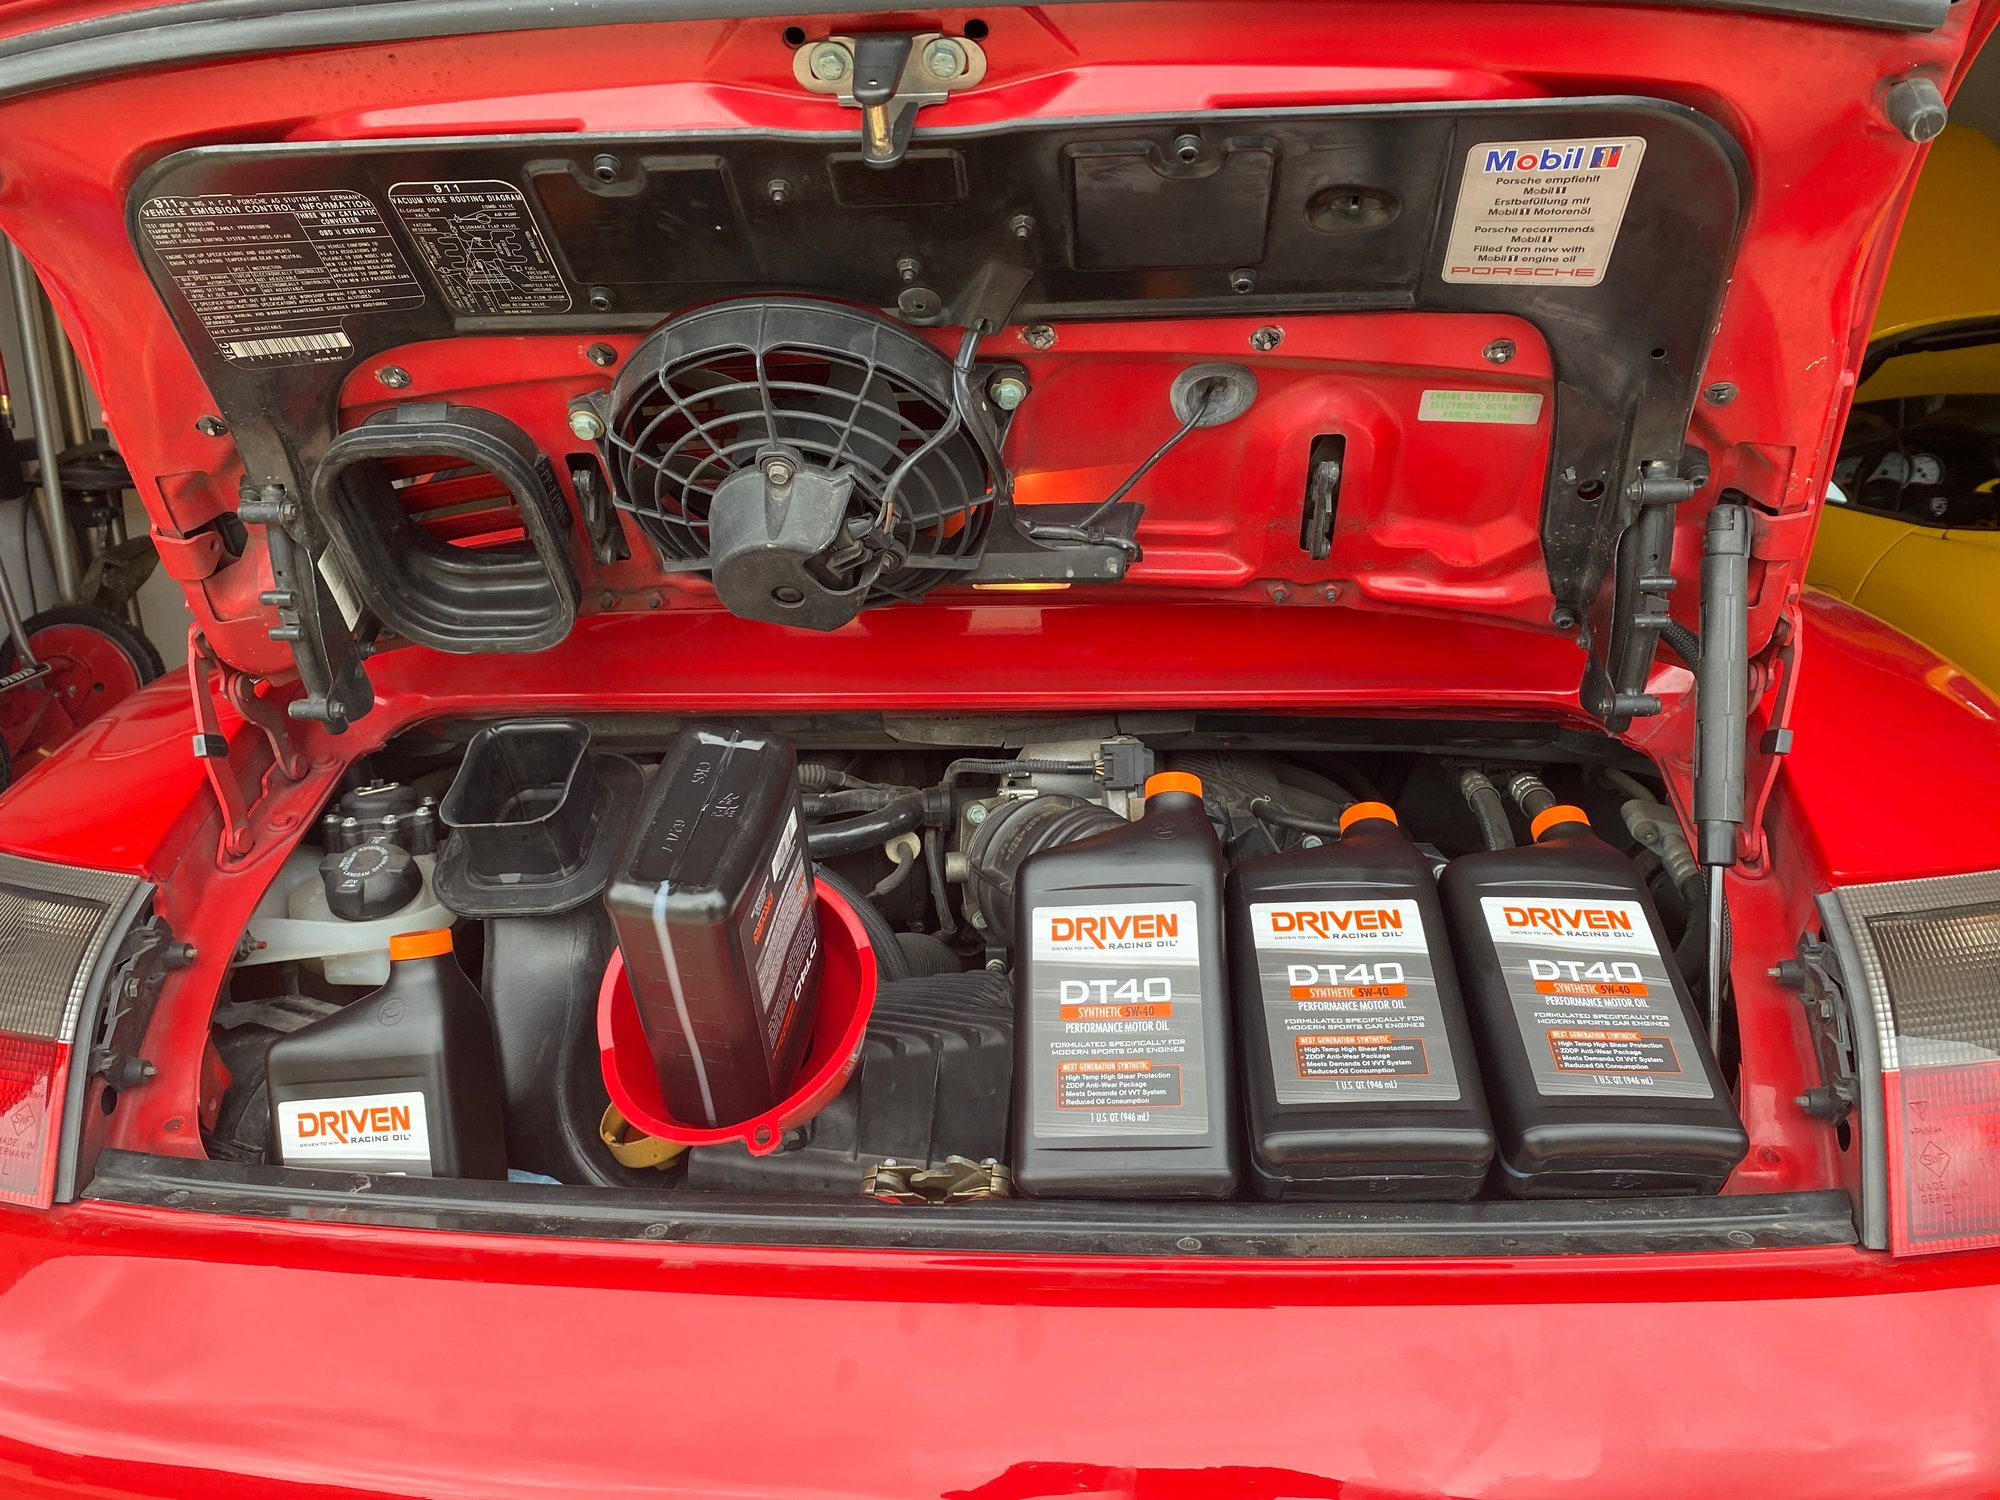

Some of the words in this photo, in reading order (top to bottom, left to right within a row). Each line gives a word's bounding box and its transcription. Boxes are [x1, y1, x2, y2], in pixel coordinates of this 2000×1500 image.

[1485, 146, 1584, 172] Mobil
[1496, 177, 1541, 185] Porsche
[1545, 175, 1600, 184] empfiehlt
[434, 184, 460, 193] 911
[154, 199, 178, 208] 911
[1494, 198, 1568, 206] Erstbefüllung
[142, 208, 187, 217] VEHICLE
[190, 206, 240, 215] EMISSION
[245, 204, 295, 213] CONTROL
[299, 200, 371, 210] INFORMATION
[1451, 267, 1595, 277] PORSCHE
[1271, 910, 1402, 939] DRIVEN
[1503, 907, 1632, 936] DRIVEN
[1052, 914, 1178, 949] DRIVEN
[1109, 941, 1152, 950] RACING
[794, 937, 817, 1002] DT40
[1287, 963, 1404, 986] DT40
[1527, 960, 1643, 983] DT40
[1060, 977, 1172, 1004] DT40
[1310, 988, 1355, 998] SYNTHETIC
[1358, 987, 1389, 997] 5W-40
[1555, 984, 1599, 994] SYNTHETIC
[1600, 985, 1630, 994] 5W-40
[1299, 1001, 1359, 1011] PERFORMANCE
[1360, 1000, 1390, 1010] MOTOR
[1393, 1000, 1406, 1009] OIL
[1545, 996, 1603, 1007] PERFORMANCE
[1604, 997, 1634, 1007] MOTOR
[1636, 998, 1649, 1008] OIL
[1078, 1007, 1122, 1018] SYNTHETIC
[1126, 1006, 1154, 1017] 5W-40
[1066, 1021, 1123, 1033] PERFORMANCE
[1125, 1021, 1154, 1032] MOTOR
[1156, 1021, 1169, 1031] OIL
[1090, 1113, 1094, 1122] 1
[1096, 1113, 1108, 1122] U.S.
[1121, 1112, 1136, 1122] (946
[1137, 1112, 1149, 1122] mL)
[297, 1106, 411, 1144] DRIVEN
[351, 1135, 389, 1144] RACING
